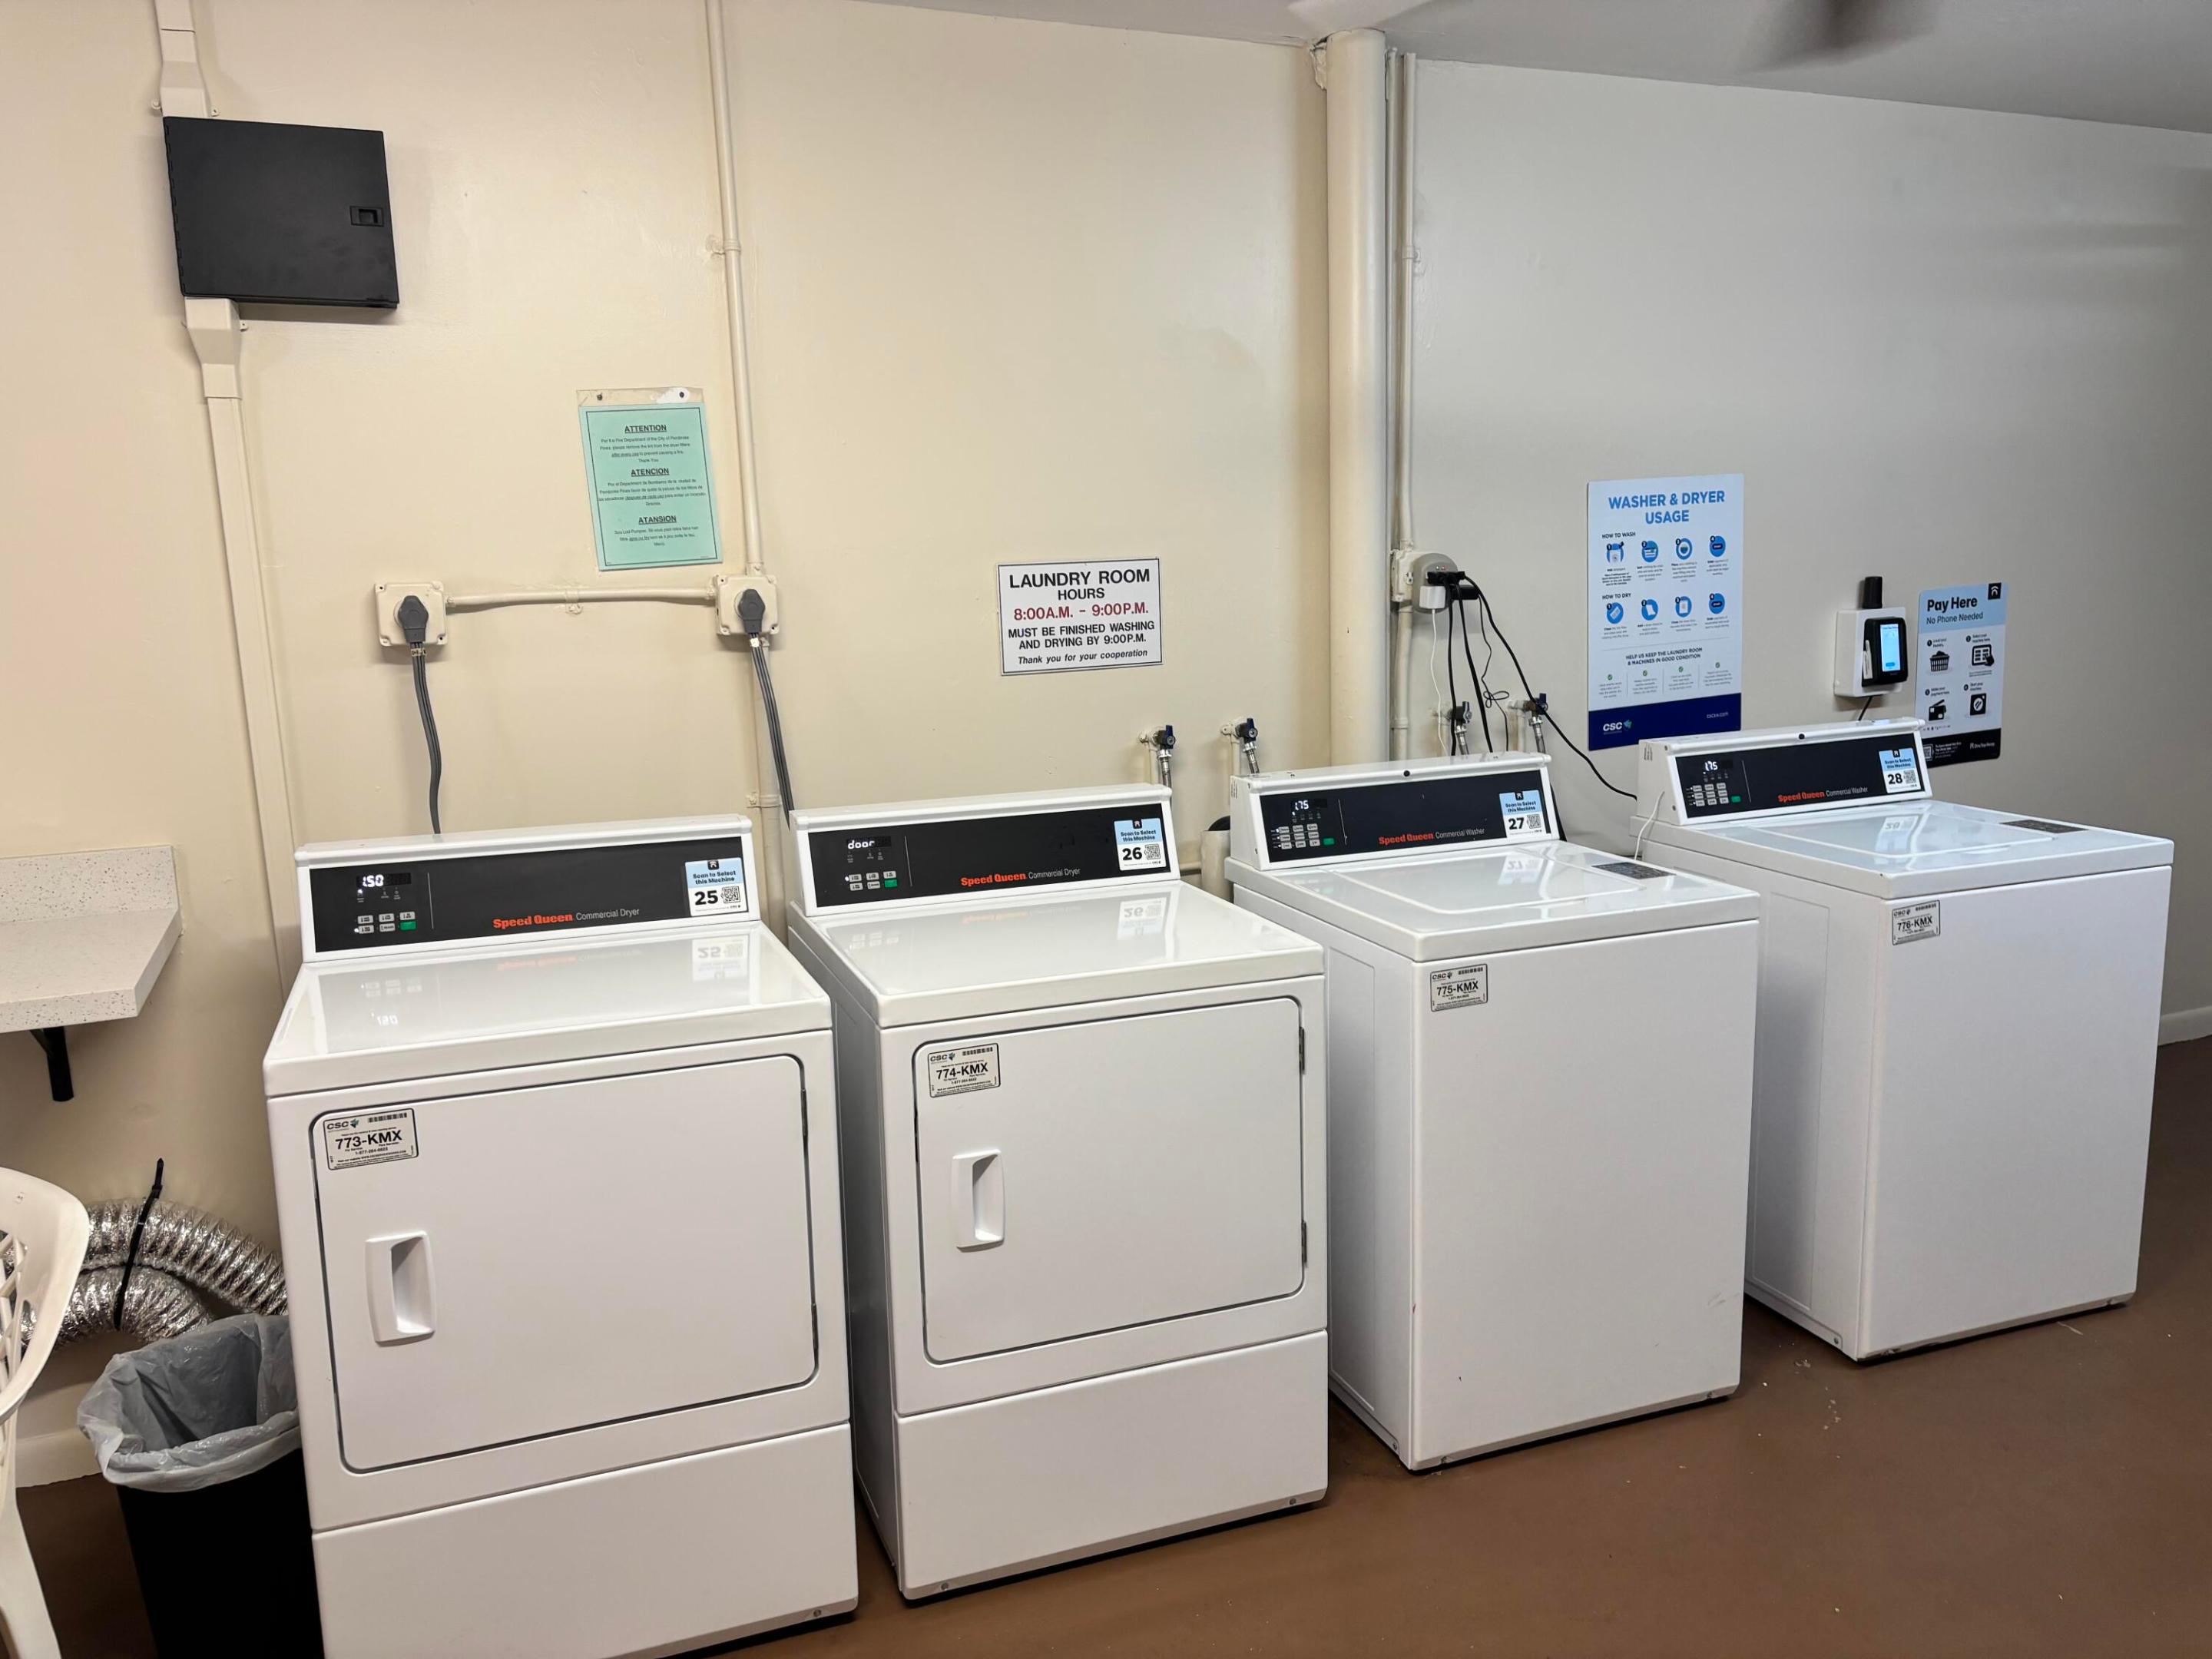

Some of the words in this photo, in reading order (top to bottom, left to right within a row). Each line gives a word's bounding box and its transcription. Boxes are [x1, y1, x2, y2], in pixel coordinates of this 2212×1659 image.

[625, 424, 667, 433] ATTENTION
[631, 468, 670, 476] ATENCION
[1608, 494, 1666, 509] WASHER
[1670, 493, 1677, 505] &
[1682, 490, 1725, 505] DRYER
[638, 515, 677, 525] ATANSION
[1645, 510, 1689, 524] USAGE
[1009, 571, 1091, 588] LAUNDRY
[1099, 569, 1150, 584] ROOM
[1058, 588, 1105, 601] HOURS
[1014, 606, 1073, 621] 8:00A.M.
[1091, 602, 1148, 617] 9:00P.M.
[1927, 599, 1949, 613] Pay
[1951, 597, 1977, 608] Here
[1937, 615, 1957, 624] Phone
[1959, 612, 1983, 621] Needed
[1008, 628, 1038, 638] MUST
[1042, 627, 1055, 636] BE
[1060, 624, 1106, 635] FINISHED
[1109, 621, 1155, 632] WASHING
[1019, 640, 1040, 650] AND
[1045, 637, 1083, 648] DRYING
[1087, 636, 1099, 645] BY
[1104, 634, 1146, 644] 9:00P.M.
[1018, 656, 1042, 664] Thank
[1046, 655, 1061, 664] you
[1079, 653, 1097, 662] your
[1101, 649, 1147, 660] cooperation
[1603, 722, 1623, 732] CSC
[1888, 773, 1902, 784] 28
[1778, 793, 1801, 803] Speed
[1802, 791, 1825, 799] Queen
[1826, 789, 1851, 797] Commercial
[1508, 817, 1524, 830] 27
[848, 839, 875, 849] door
[1379, 834, 1406, 845] Speed
[1407, 833, 1434, 841] Queen
[1435, 830, 1465, 839] Commercial
[1122, 847, 1142, 860] 26
[961, 875, 993, 887] Speed
[994, 873, 1027, 883] Queen
[1028, 869, 1063, 879] Commercial
[1064, 868, 1081, 877] Dryer
[694, 890, 718, 905] 25
[493, 916, 532, 929] Speed
[534, 913, 573, 924] Queen
[576, 909, 618, 921] Commercial
[620, 908, 639, 918] Dryer
[1437, 981, 1479, 995] 775-KMX
[936, 1062, 988, 1080] 774-KMX
[327, 1121, 349, 1129] CSC
[335, 1130, 402, 1149] 773-KMX
